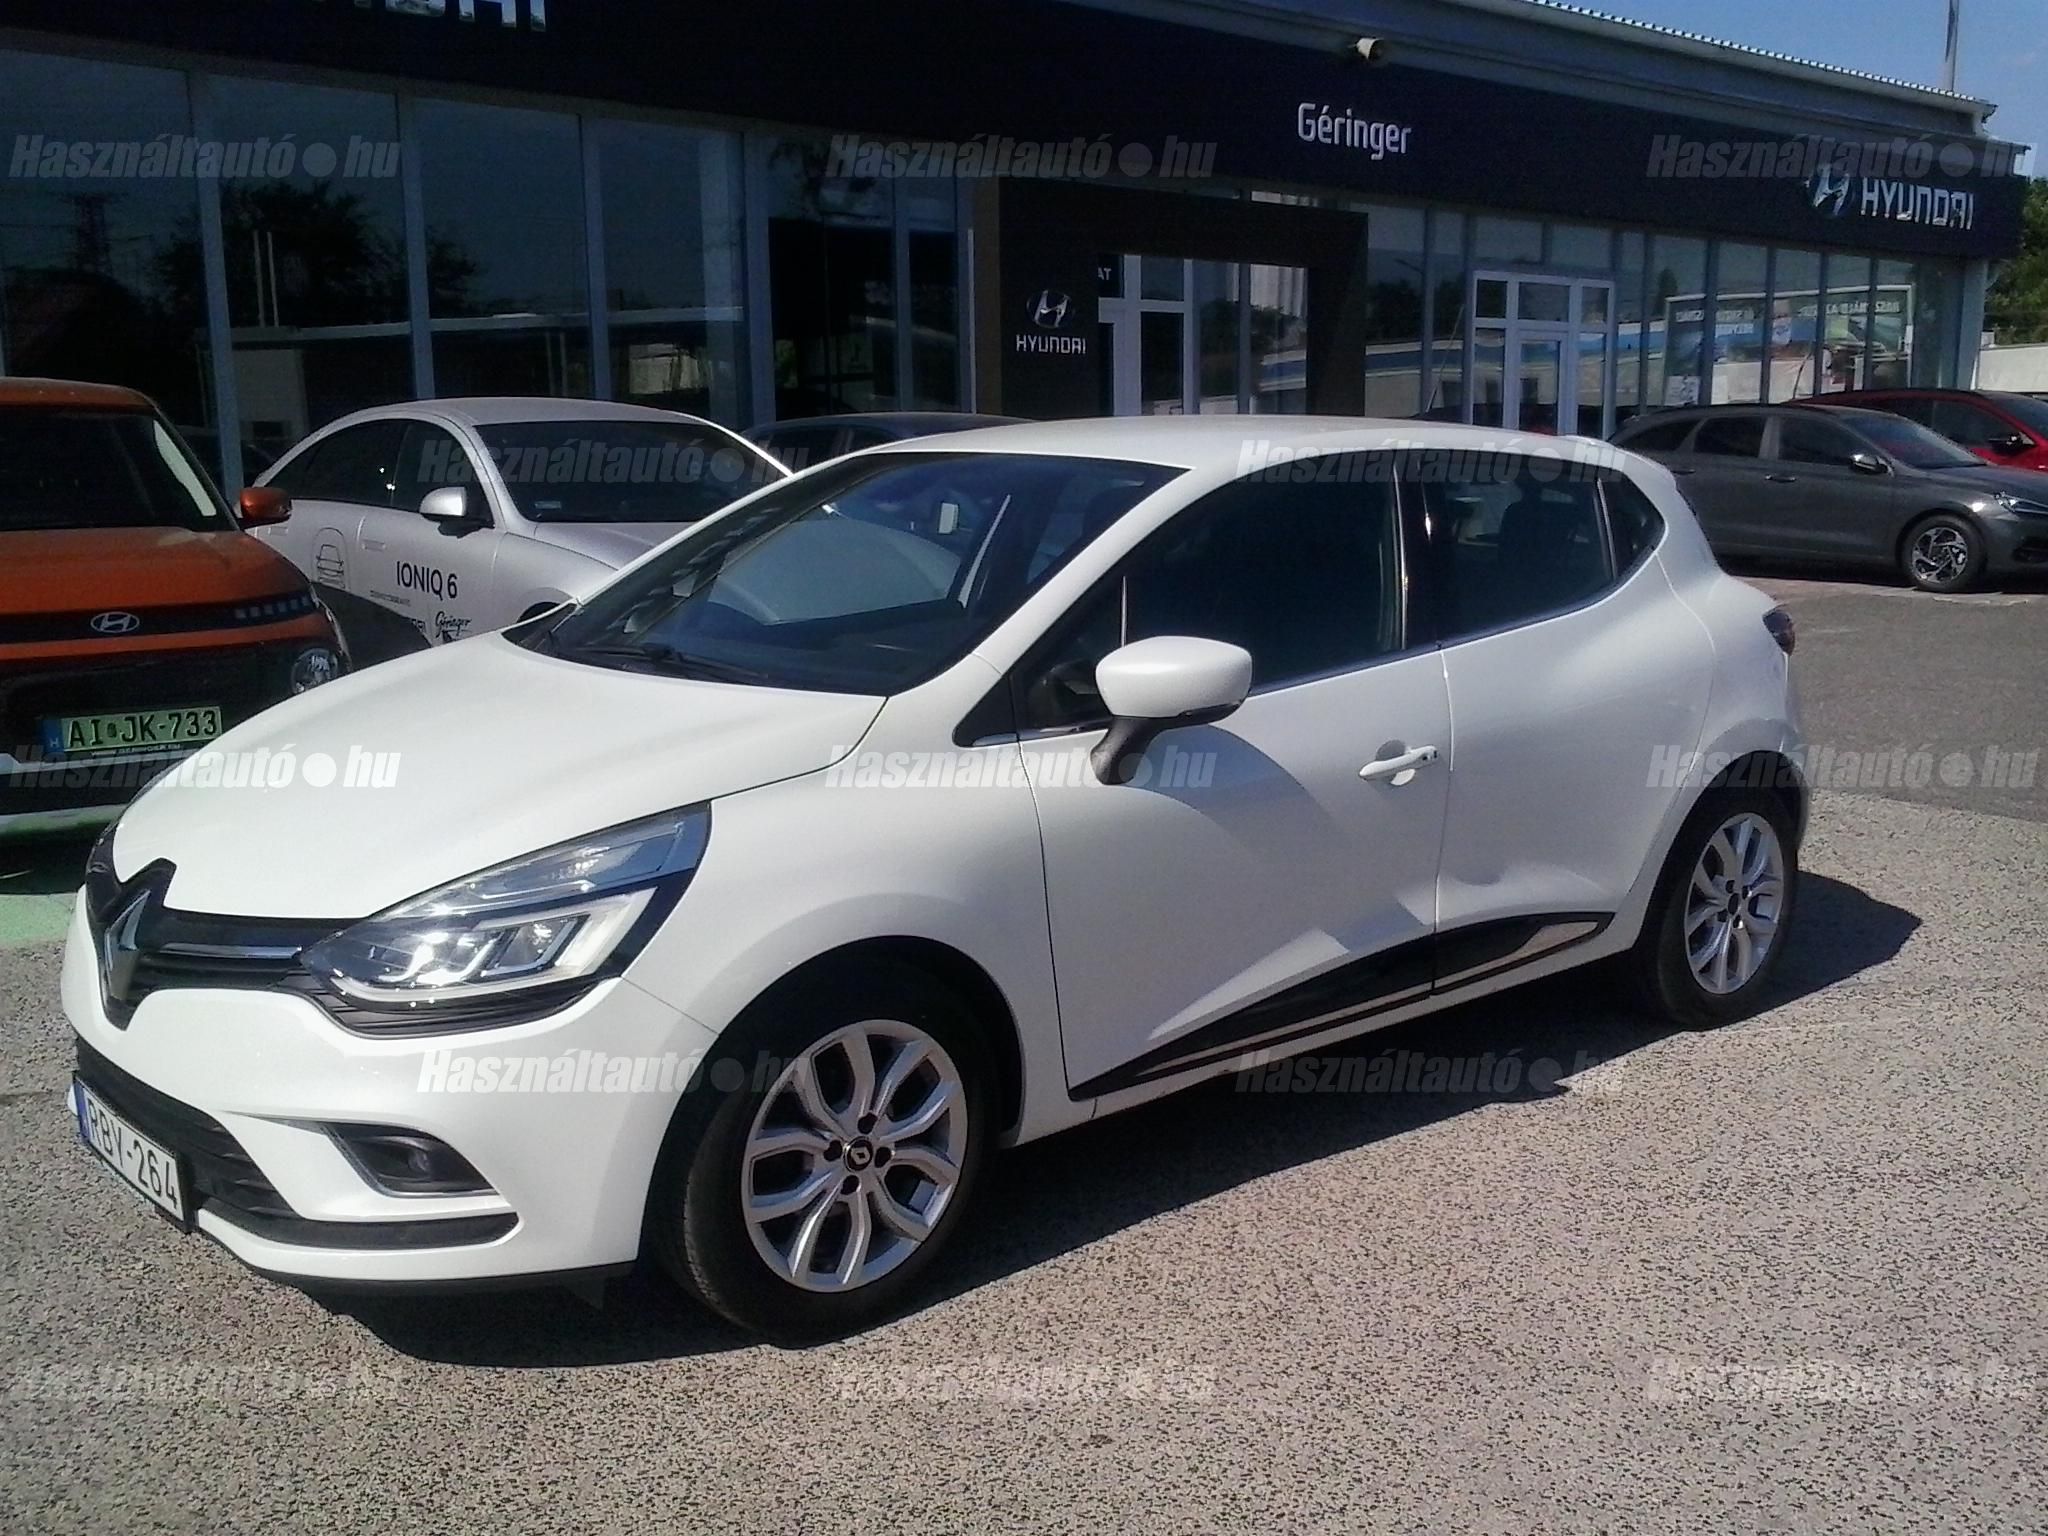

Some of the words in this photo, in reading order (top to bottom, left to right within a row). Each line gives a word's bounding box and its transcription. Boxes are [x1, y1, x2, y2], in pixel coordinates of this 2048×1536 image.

[1297, 102, 1412, 160] Géringer
[1860, 176, 1974, 231] HYUNDAI
[1016, 334, 1087, 355] HYUNDAI
[397, 560, 443, 601] IONIQ
[447, 573, 458, 599] 6
[88, 1098, 177, 1209] RBY-264
